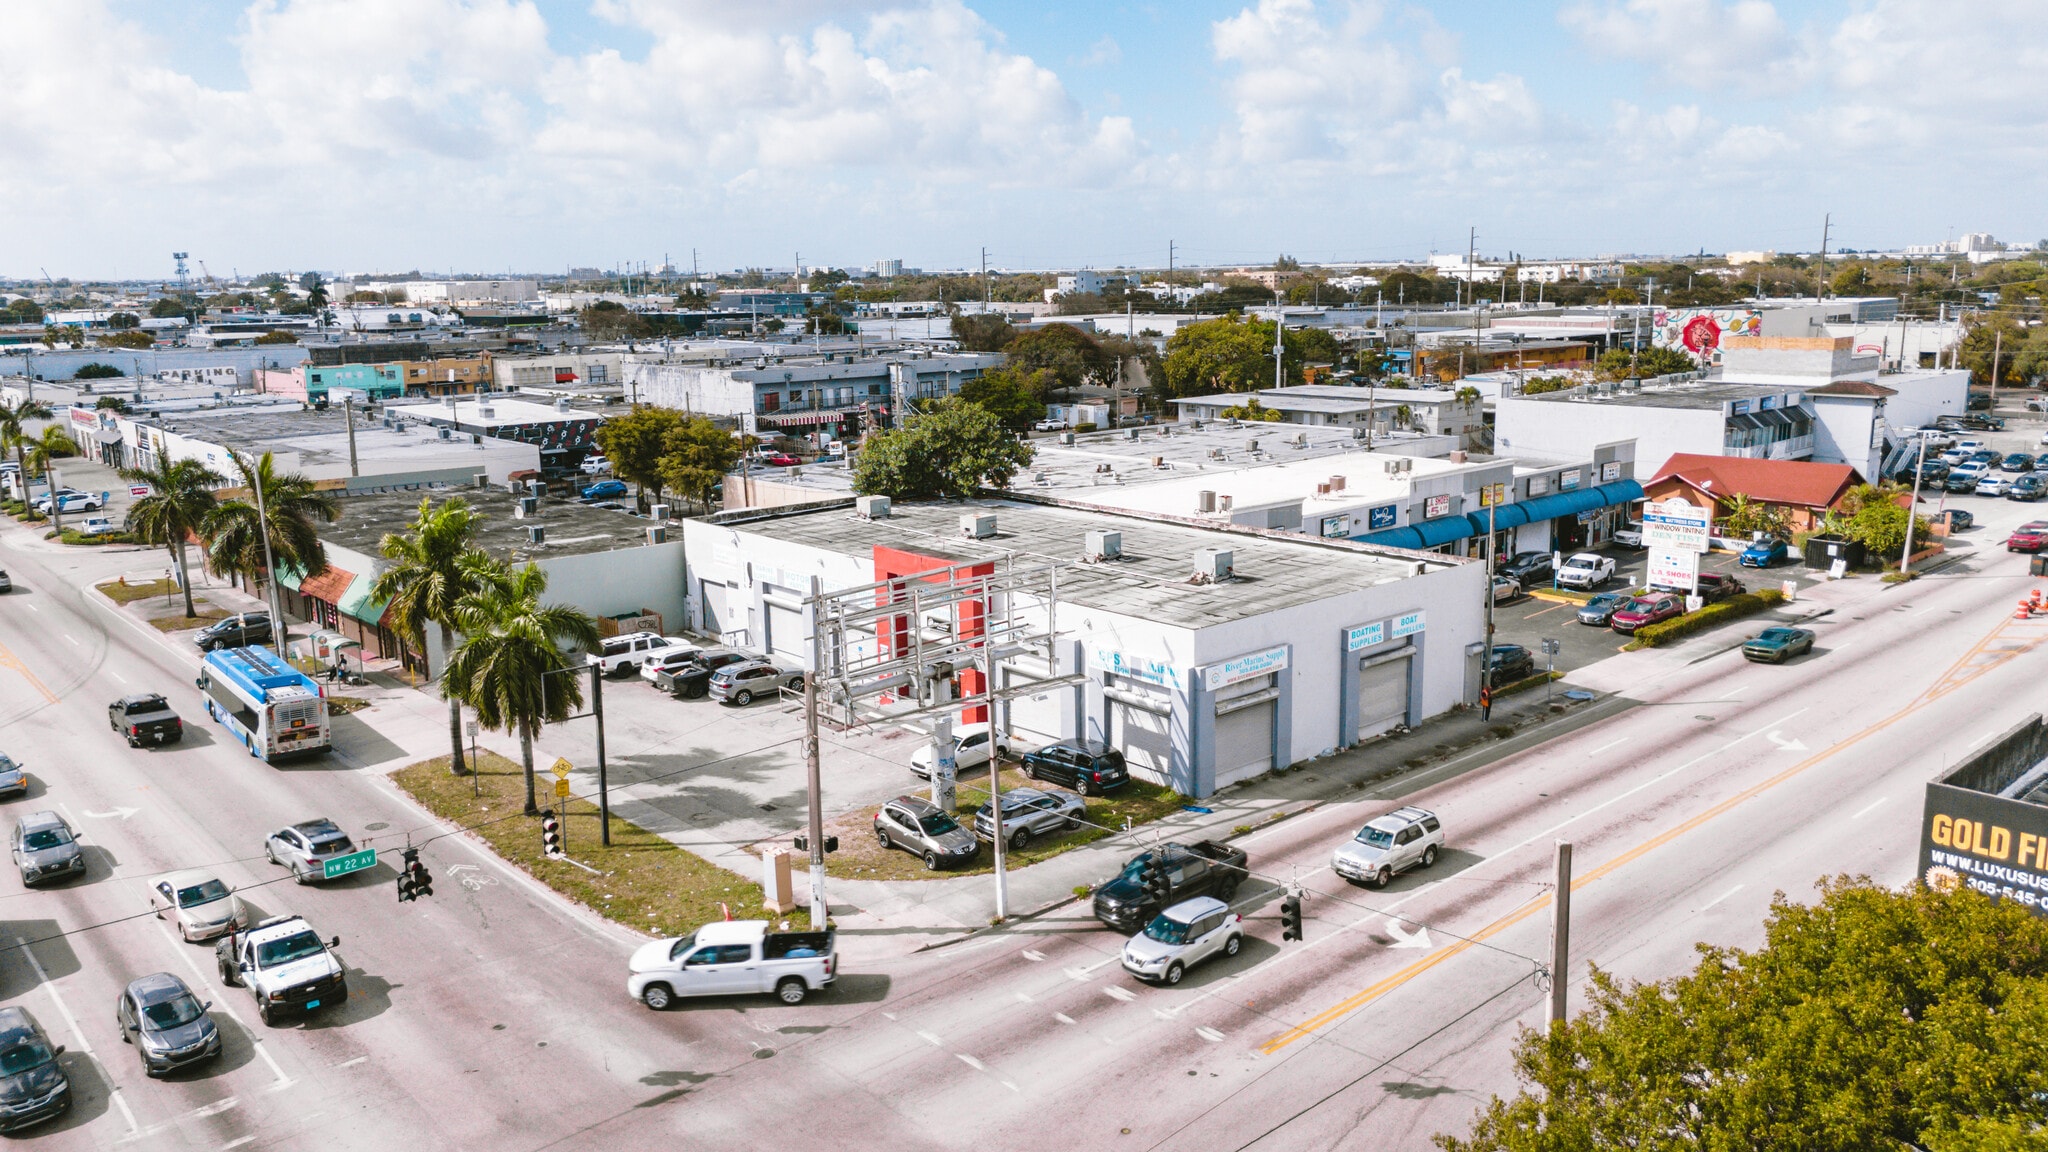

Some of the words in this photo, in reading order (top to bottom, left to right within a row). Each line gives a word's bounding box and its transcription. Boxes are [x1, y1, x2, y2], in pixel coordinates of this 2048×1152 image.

[160, 368, 235, 378] PARKING
[1654, 524, 1681, 532] WINDOW
[1682, 526, 1705, 536] TINTING
[784, 571, 810, 584] MOTOR
[1666, 570, 1691, 580] SHOES
[1400, 615, 1418, 626] BOAT
[1351, 624, 1381, 639] BOATING
[1392, 623, 1425, 637] PROPELLERS
[1350, 634, 1382, 649] SUPPLIES
[1098, 650, 1121, 666] GPS
[1225, 661, 1243, 673] River
[1243, 656, 1265, 666] Marine
[1266, 648, 1285, 661] Supply
[1931, 813, 2011, 860] GOLD
[2017, 831, 2048, 871] FI
[329, 864, 341, 873] NW
[344, 859, 357, 870] 22
[361, 856, 372, 865] AV
